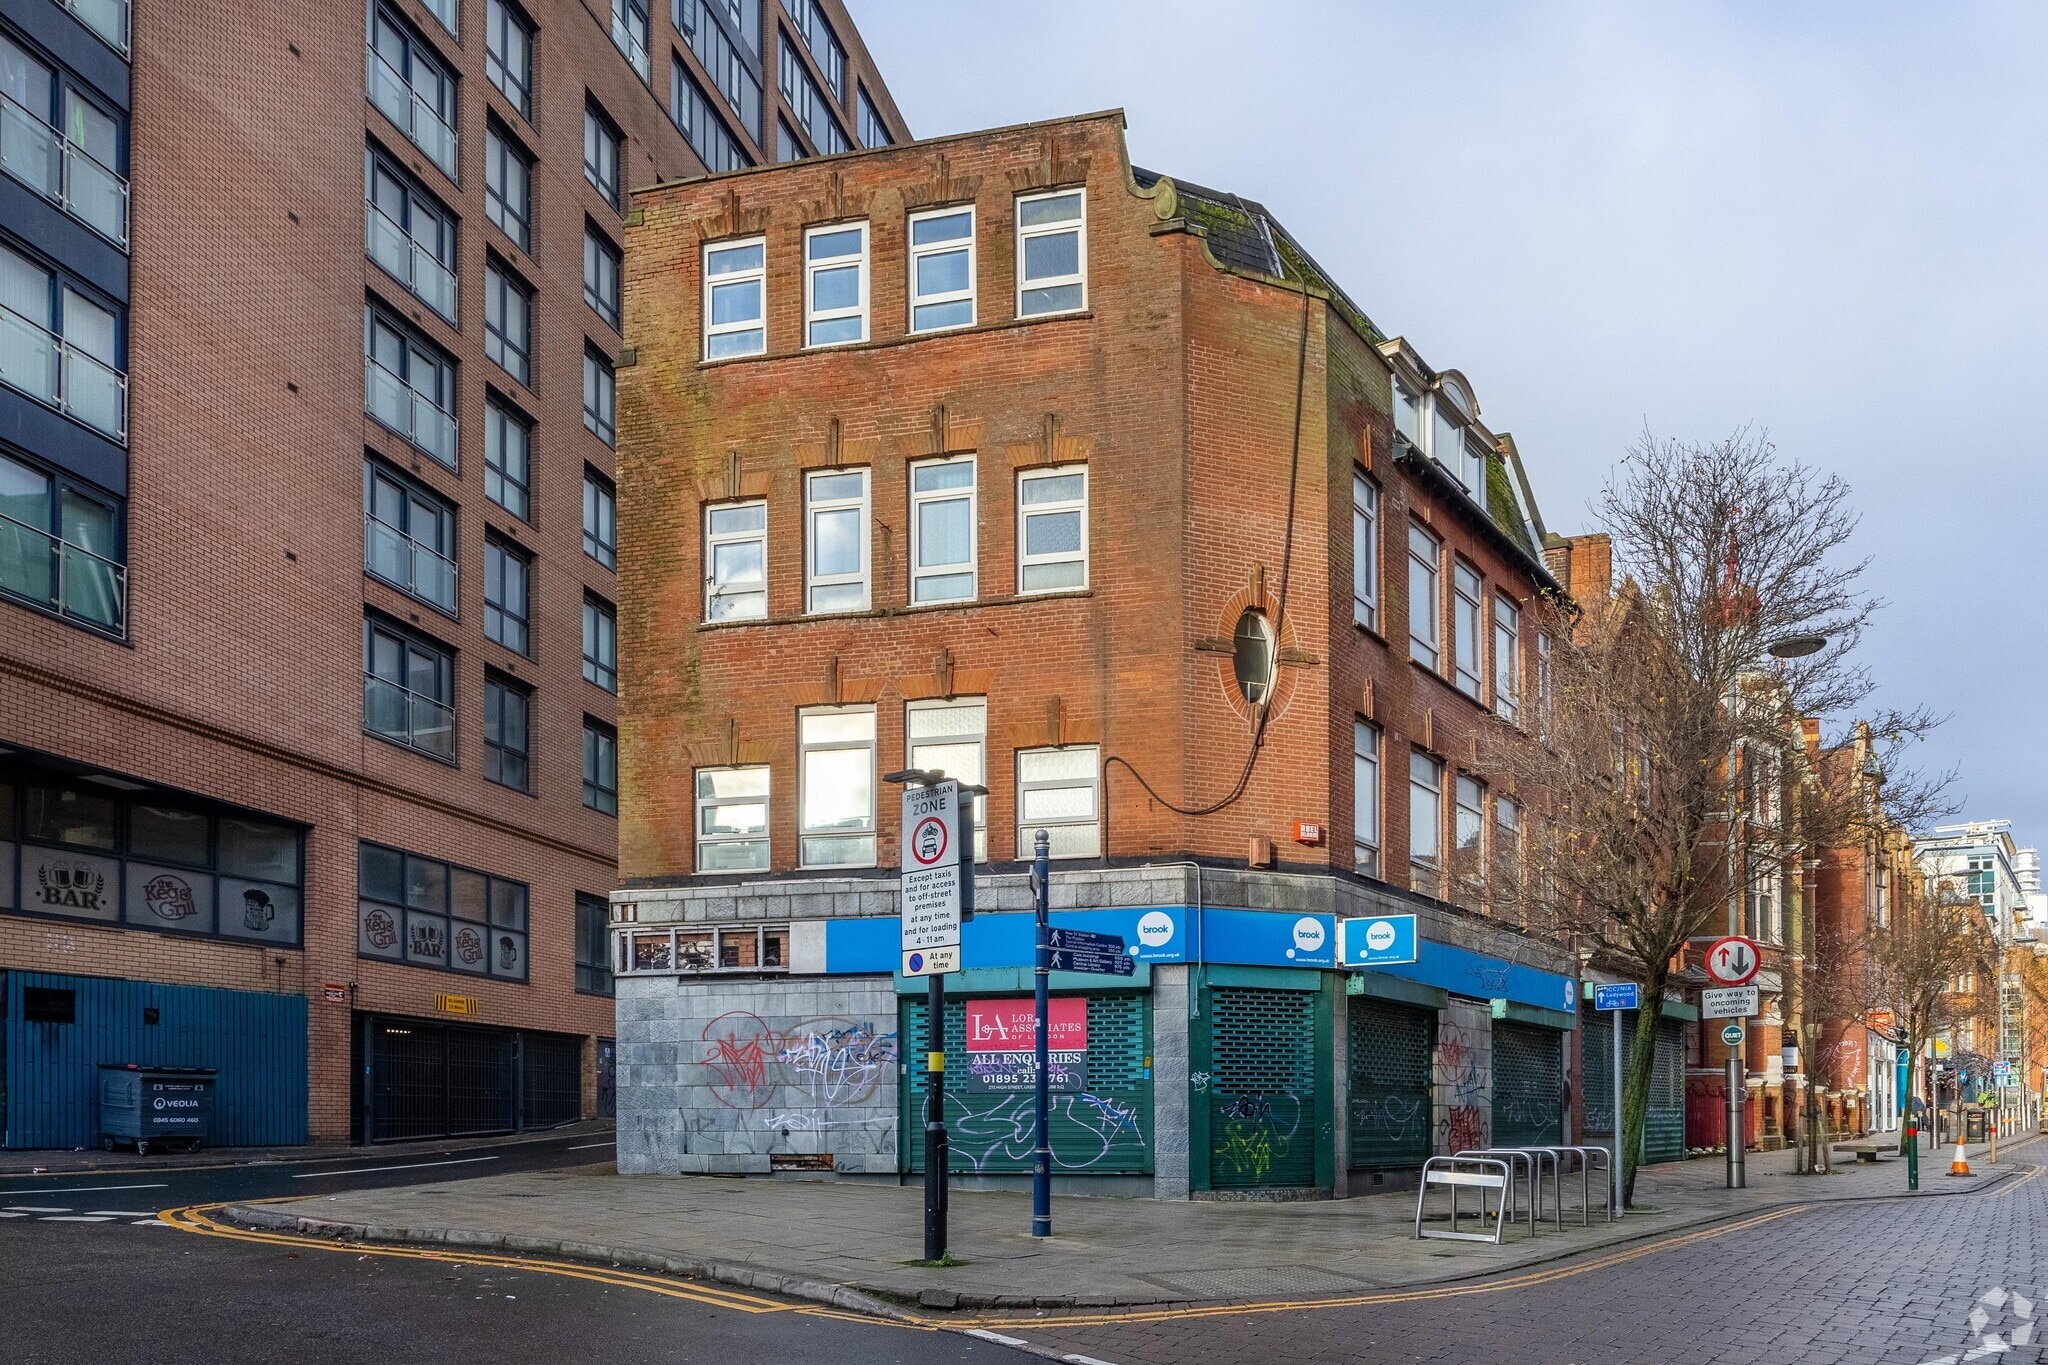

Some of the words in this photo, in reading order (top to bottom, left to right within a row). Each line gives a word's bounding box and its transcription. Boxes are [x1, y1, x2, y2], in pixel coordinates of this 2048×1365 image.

[906, 785, 953, 802] PEDESTRIAN
[913, 798, 946, 816] ZONE
[909, 873, 932, 883] Except
[935, 870, 952, 879] taxis
[157, 880, 173, 888] the
[905, 885, 918, 893] and
[931, 880, 956, 889] access
[42, 886, 101, 911] BAR
[143, 884, 179, 901] Keg
[918, 889, 952, 900] off-street
[159, 900, 198, 917] Grill
[914, 901, 946, 912] premises
[935, 912, 950, 920] time
[364, 918, 387, 933] Keg
[904, 927, 917, 935] and
[931, 923, 957, 932] loading
[1143, 924, 1168, 934] brook
[374, 931, 398, 945] Grill
[1298, 930, 1320, 939] brook
[1371, 932, 1391, 940] brook
[413, 940, 442, 958] BAR
[455, 937, 474, 950] Keg
[463, 948, 484, 961] Grill
[930, 952, 938, 960] At
[933, 961, 949, 969] time
[1710, 998, 1751, 1007] oncoming
[1713, 1007, 1748, 1015] vehicles
[971, 1053, 1000, 1065] ALL
[1017, 1066, 1036, 1074] call:
[983, 1074, 1018, 1083] 01895
[1022, 1074, 1069, 1083] 23761
